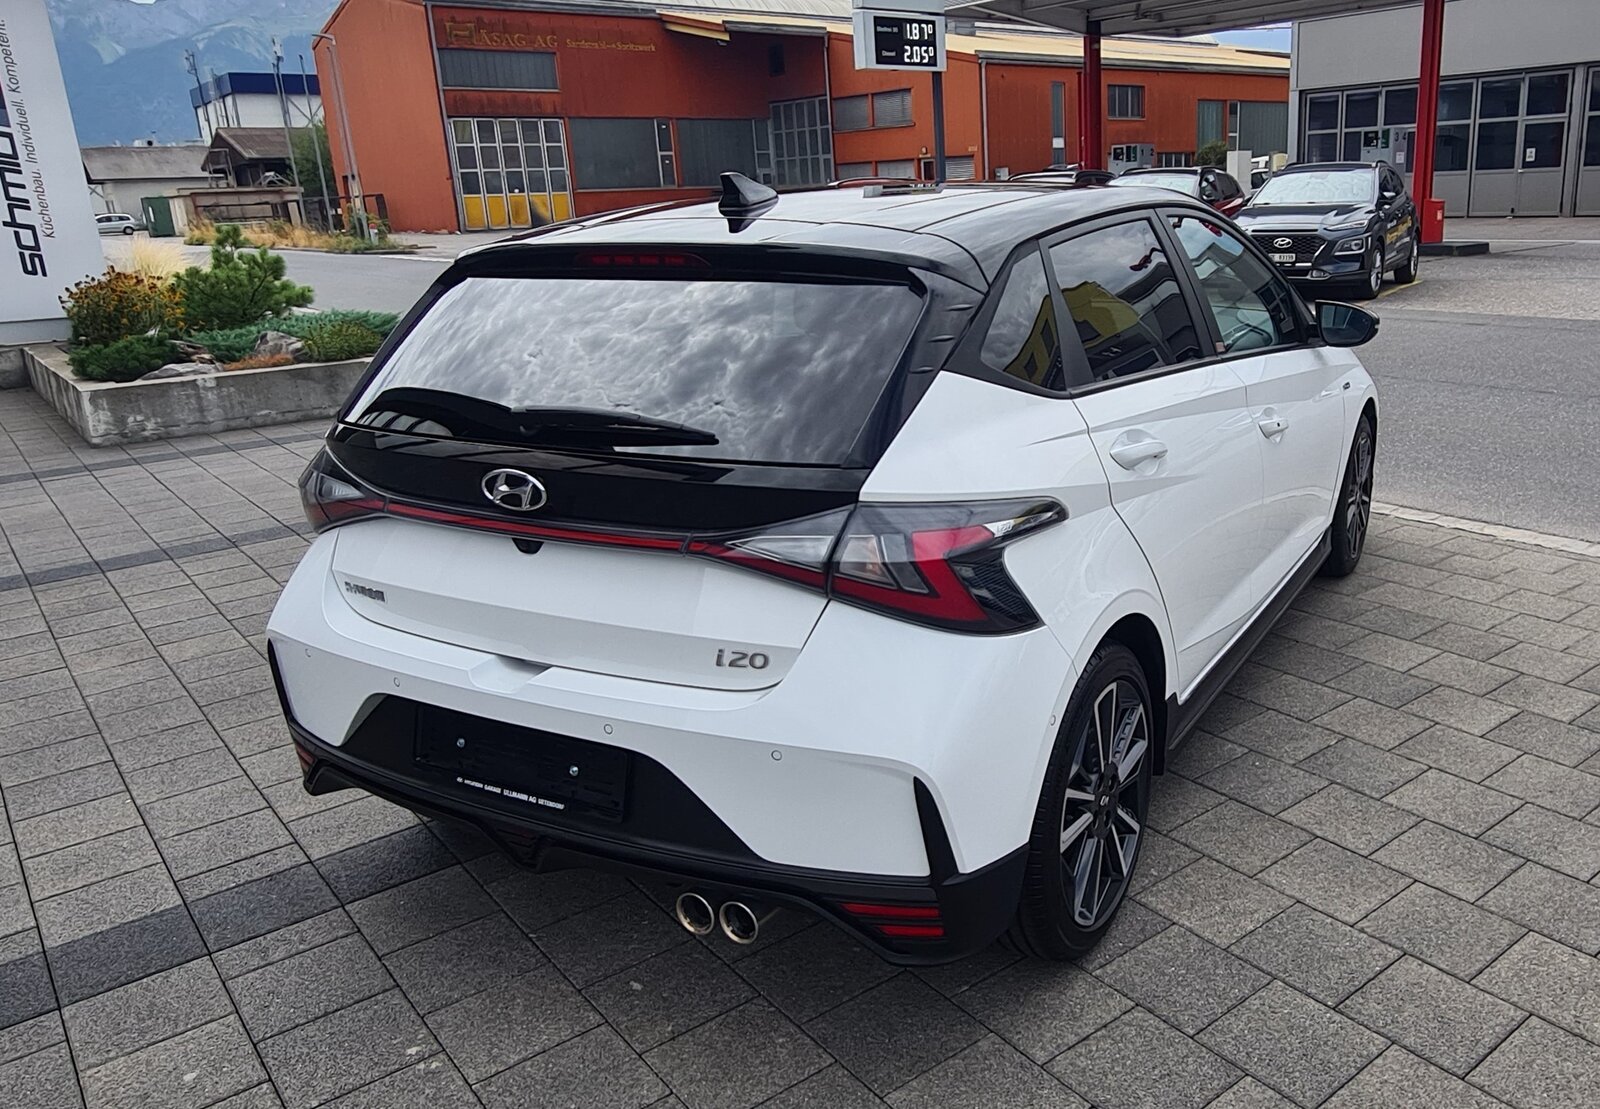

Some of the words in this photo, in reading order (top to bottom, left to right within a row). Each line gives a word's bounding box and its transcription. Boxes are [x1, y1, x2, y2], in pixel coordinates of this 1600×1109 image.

[534, 34, 558, 48] AG
[11, 98, 39, 164] Individuell.
[31, 168, 55, 239] Küchenbau.
[715, 648, 770, 670] i20
[528, 795, 537, 804] AG
